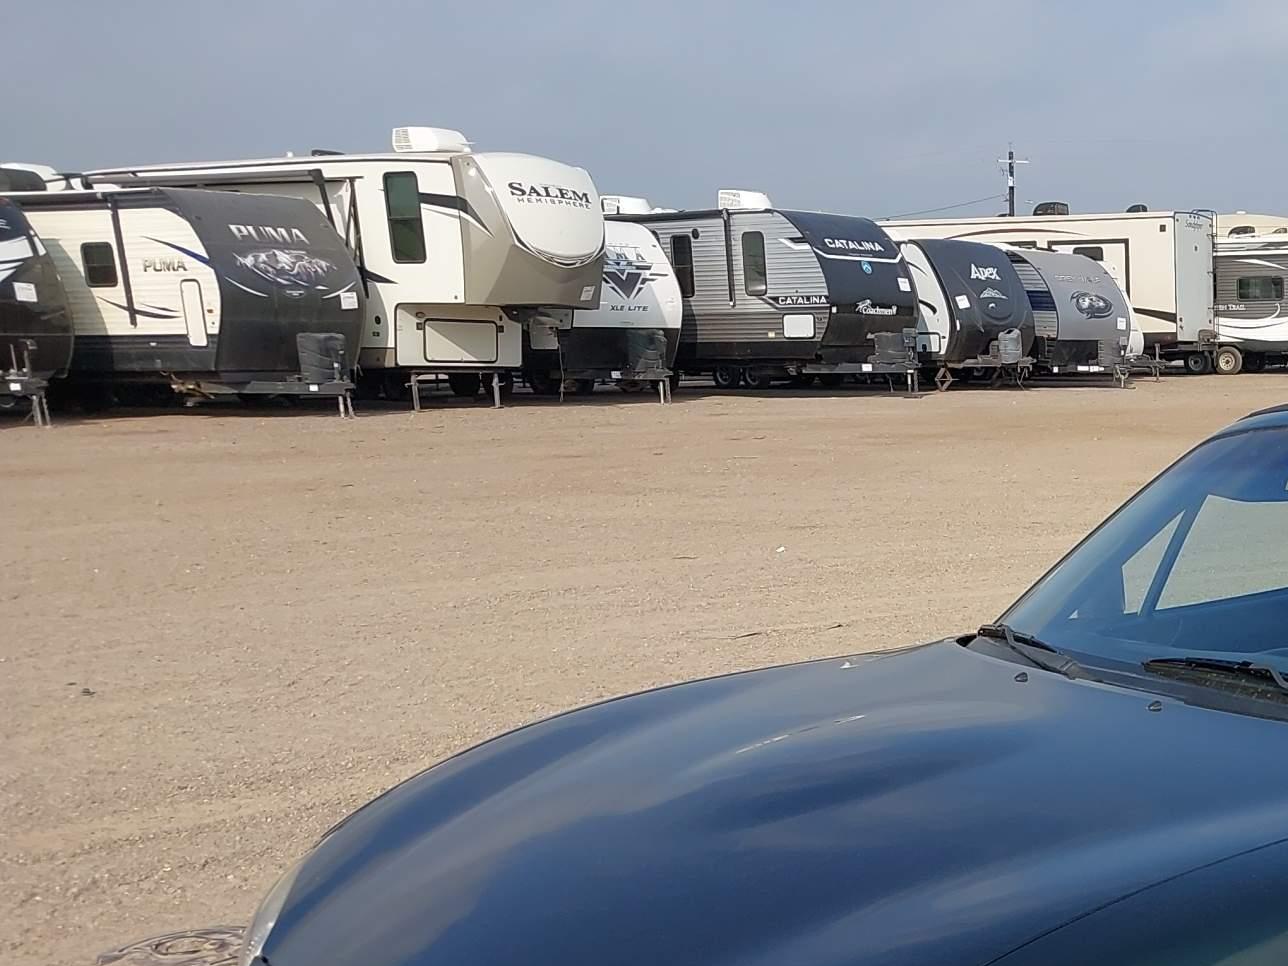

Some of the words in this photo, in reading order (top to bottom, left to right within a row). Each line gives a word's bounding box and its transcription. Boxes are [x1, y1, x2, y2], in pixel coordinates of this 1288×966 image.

[508, 182, 592, 204] SALEM
[517, 198, 591, 209] HEMISPHERE
[229, 224, 310, 245] PUMA
[823, 238, 885, 253] CATALINA
[143, 258, 188, 272] PUMA
[778, 295, 827, 305] CATALINA
[609, 304, 625, 312] XLE
[627, 304, 649, 312] LITE
